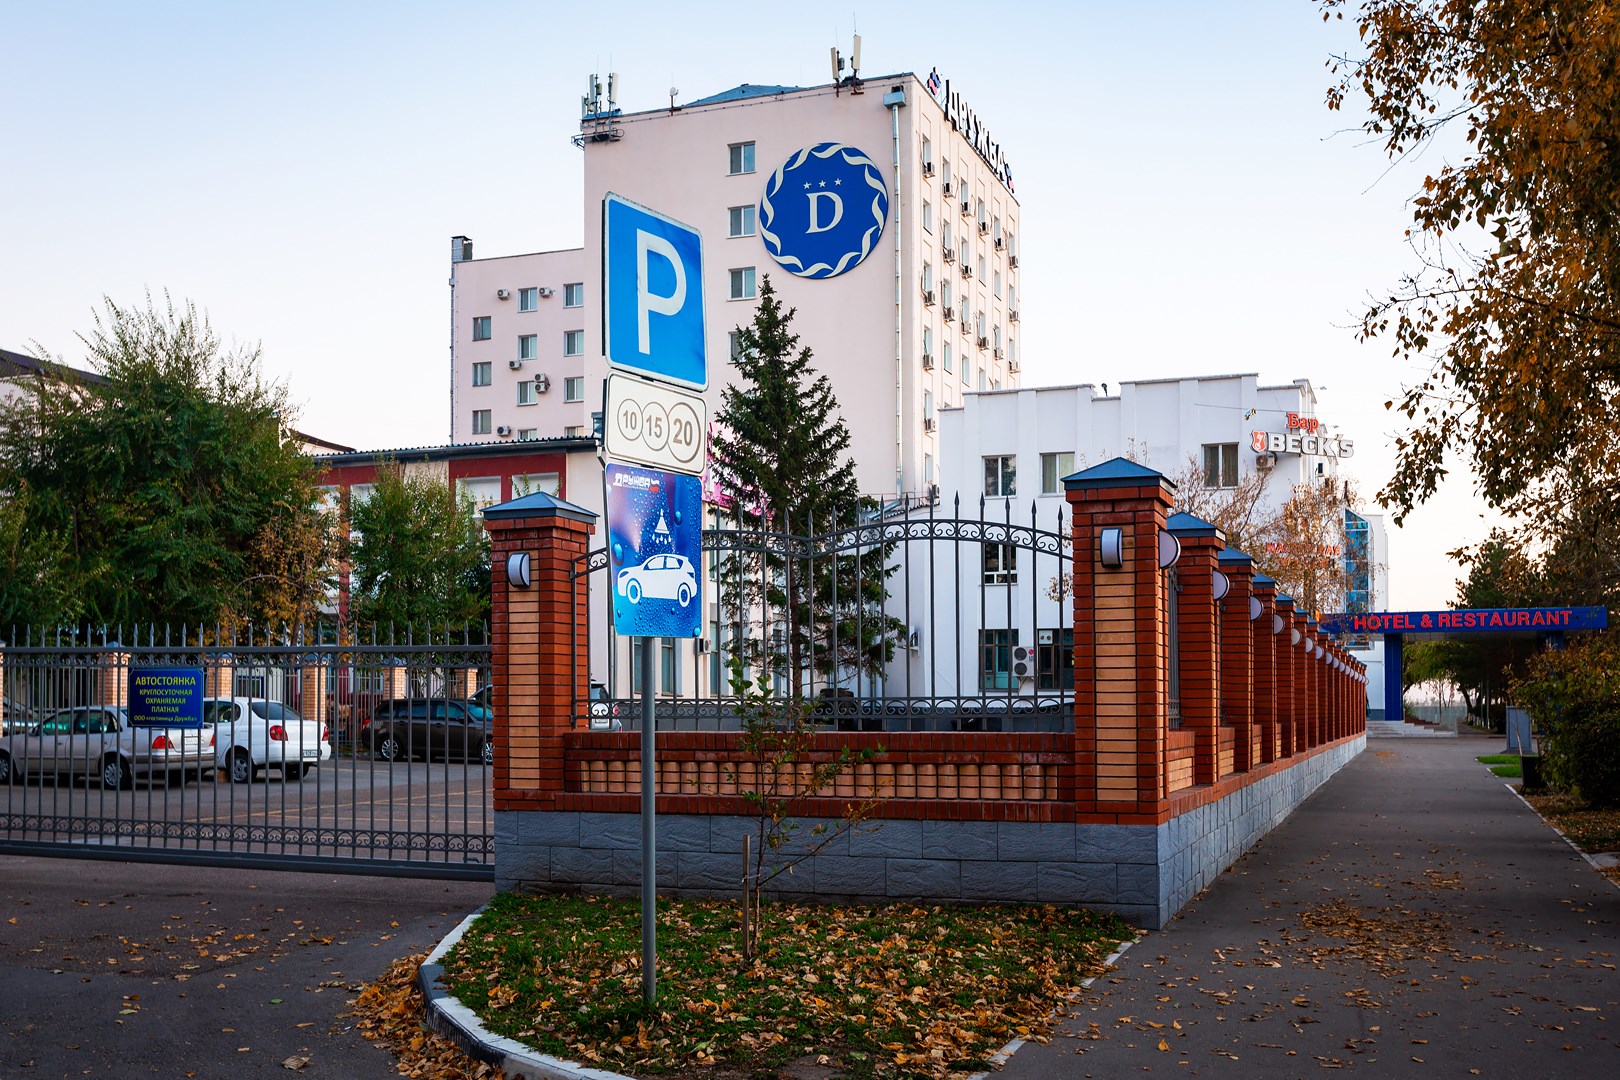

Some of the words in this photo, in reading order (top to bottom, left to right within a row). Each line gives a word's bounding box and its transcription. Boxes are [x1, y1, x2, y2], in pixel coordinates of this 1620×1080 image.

[805, 191, 844, 234] D
[636, 228, 687, 355] P
[623, 409, 637, 430] 10
[646, 414, 663, 439] 15
[672, 418, 693, 447] 20
[1286, 411, 1319, 434] Бар
[1266, 432, 1354, 458] BECK'S
[1353, 613, 1416, 630] HOTEL
[1420, 613, 1434, 629] &
[1437, 610, 1573, 629] RESTAURANT
[134, 676, 197, 686] АВТОСТОЯНКА
[139, 688, 193, 696] КРУГЛОСУТОЧНАЯ
[145, 697, 187, 705] ОХРАНЯЕМАЯ
